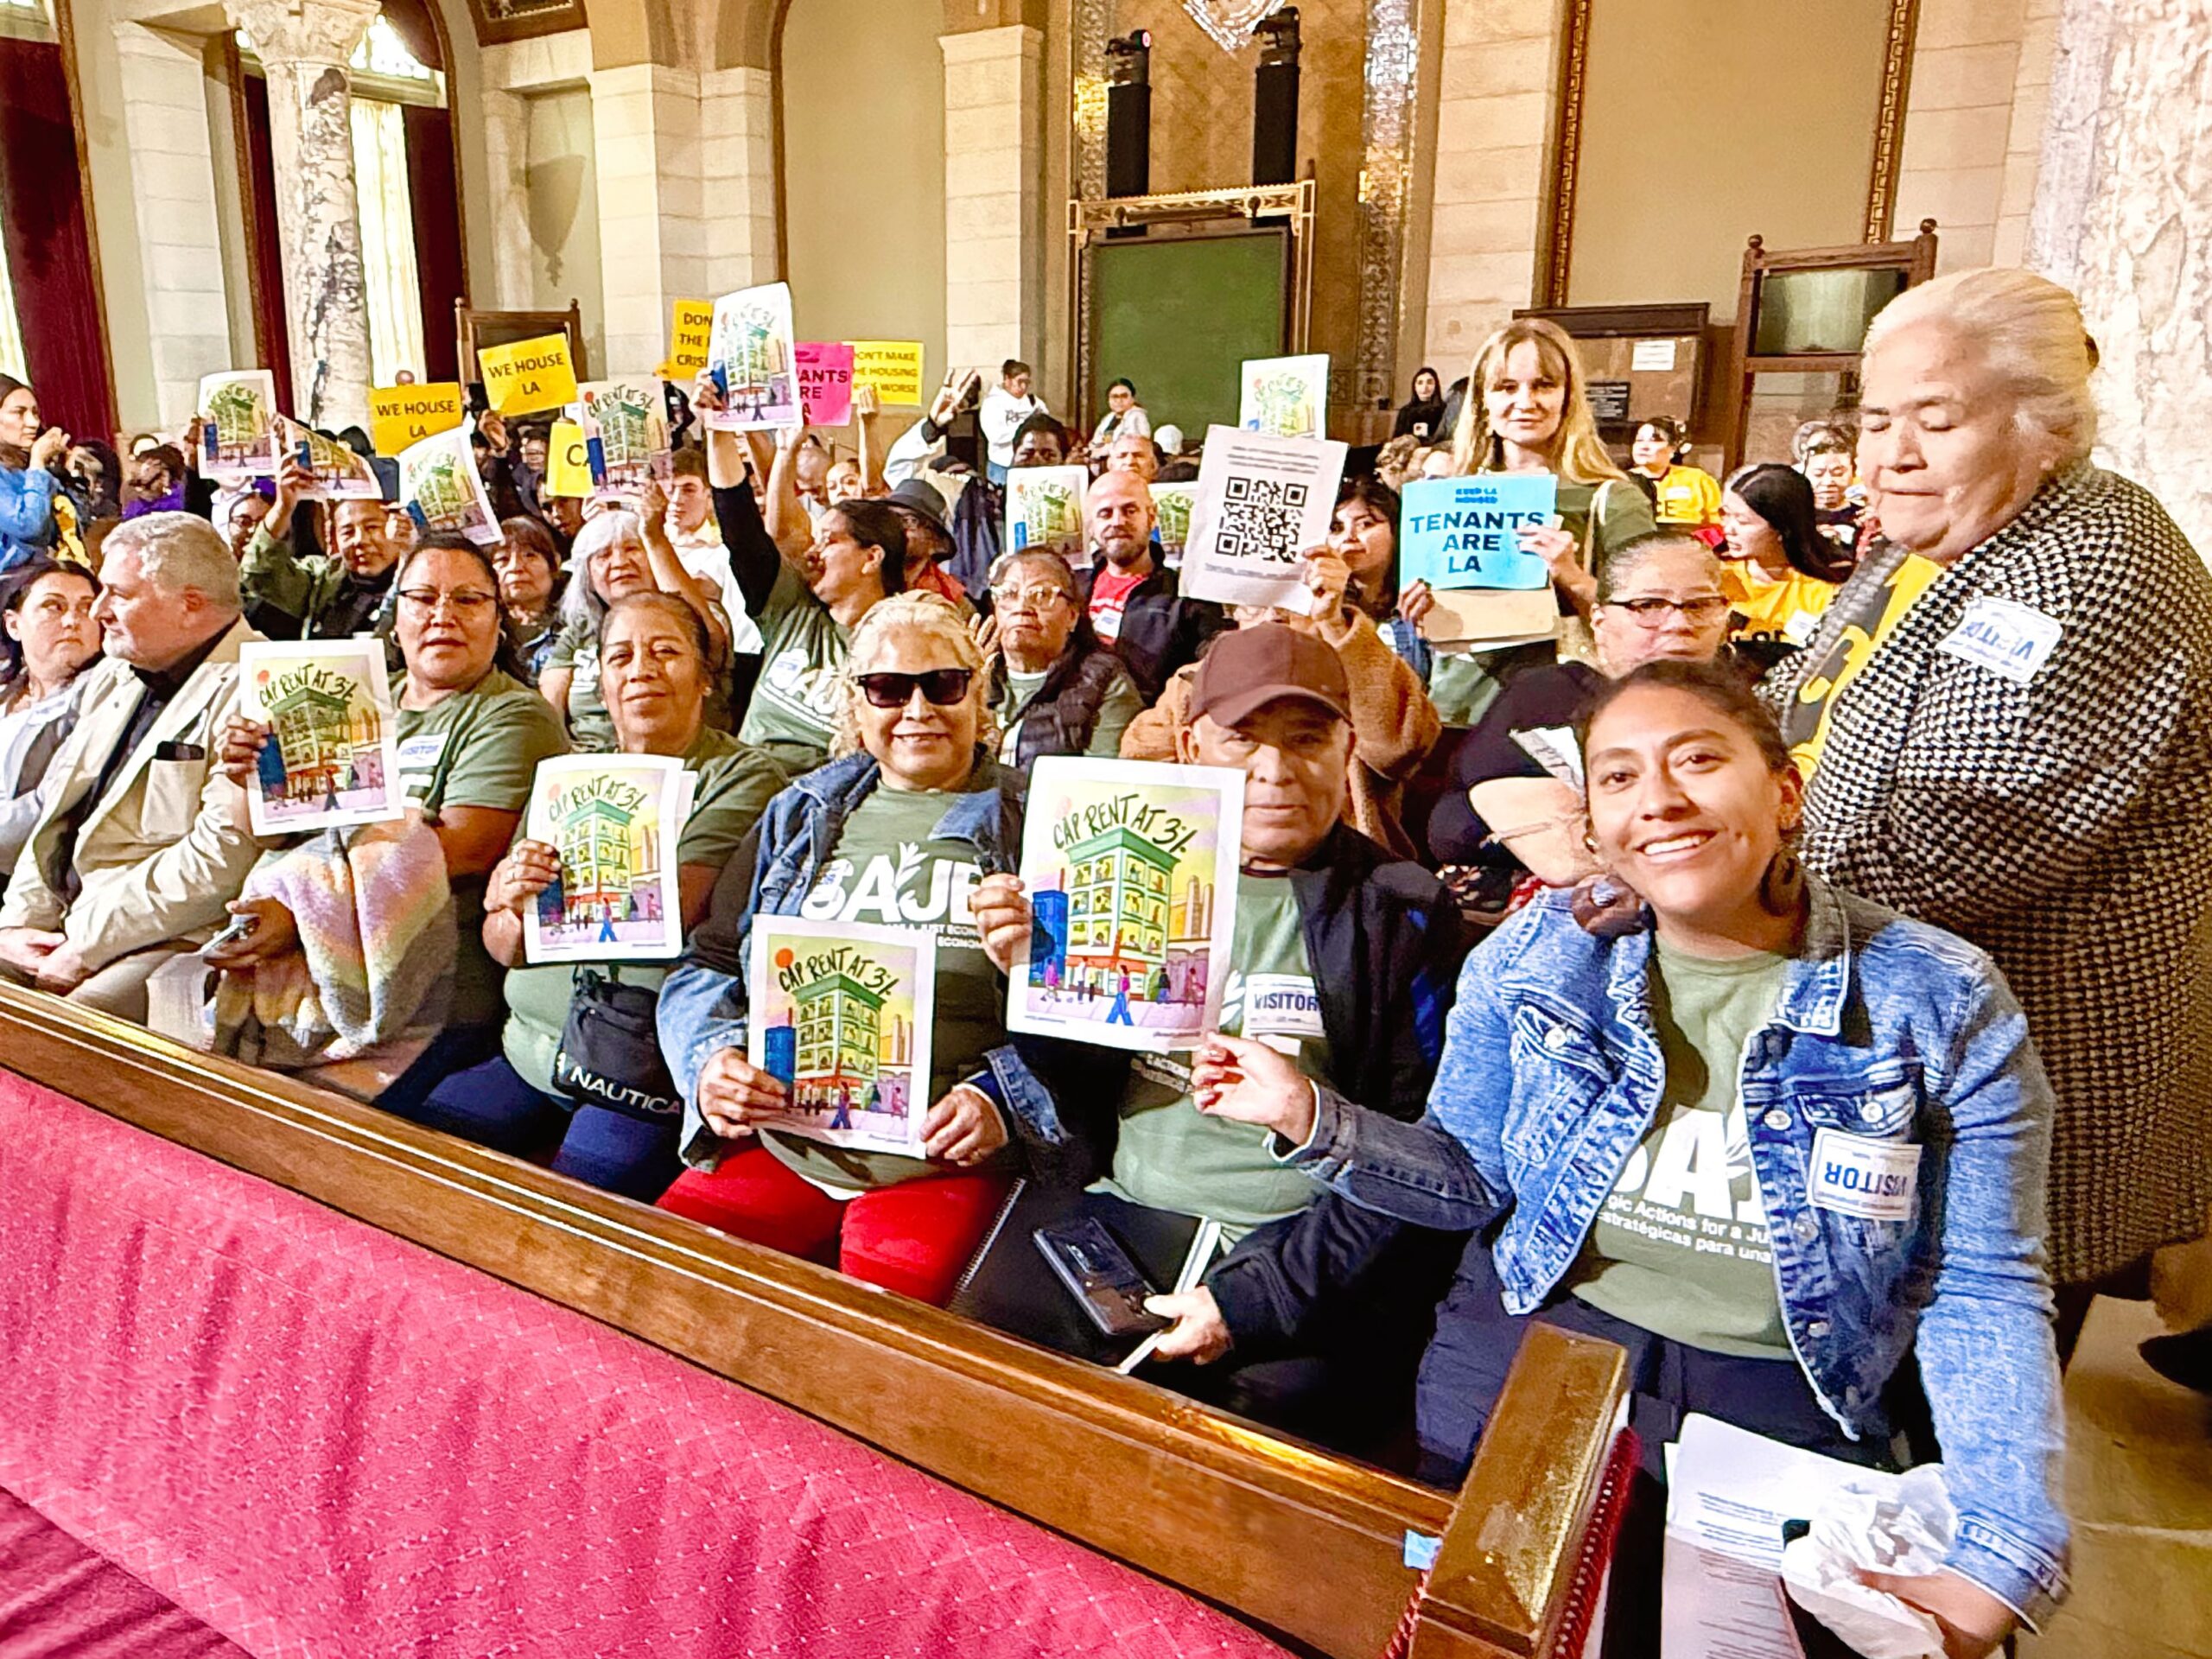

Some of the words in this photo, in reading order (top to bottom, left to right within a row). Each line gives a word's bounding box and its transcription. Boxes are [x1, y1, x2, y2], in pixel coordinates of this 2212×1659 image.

[683, 312, 713, 327] DON
[679, 334, 703, 346] THE
[488, 363, 512, 378] WE
[514, 353, 565, 372] HOUSE
[885, 352, 916, 361] MAKE
[798, 370, 848, 383] ANTS
[869, 367, 918, 378] HOUSING
[522, 382, 541, 395] LA
[800, 386, 823, 399] RE
[880, 384, 918, 394] WORSE
[377, 404, 400, 416] WE
[404, 400, 455, 415] HOUSE
[410, 425, 428, 438] LA
[1409, 512, 1545, 534] TENANTS
[1442, 533, 1502, 551] ARE
[1448, 556, 1482, 574] LA
[280, 663, 315, 697] RENT
[311, 670, 334, 689] AT
[550, 793, 568, 821] CAP
[571, 775, 609, 810] RENT
[604, 780, 626, 800] AT
[1053, 812, 1081, 849] CAP
[1084, 793, 1140, 836] RENT
[1130, 804, 1166, 833] AT
[1152, 817, 1198, 853] 3%
[779, 962, 805, 992] CAP
[806, 946, 853, 981] RENT
[847, 955, 875, 978] AT
[864, 967, 899, 995] 3%
[570, 1065, 681, 1115] NAUTICA
[1608, 1194, 1633, 1211] gic
[1633, 1200, 1698, 1230] Actions
[1701, 1217, 1727, 1236] for
[1730, 1226, 1742, 1239] a
[1746, 1230, 1770, 1244] Ju
[1695, 1238, 1734, 1256] para
